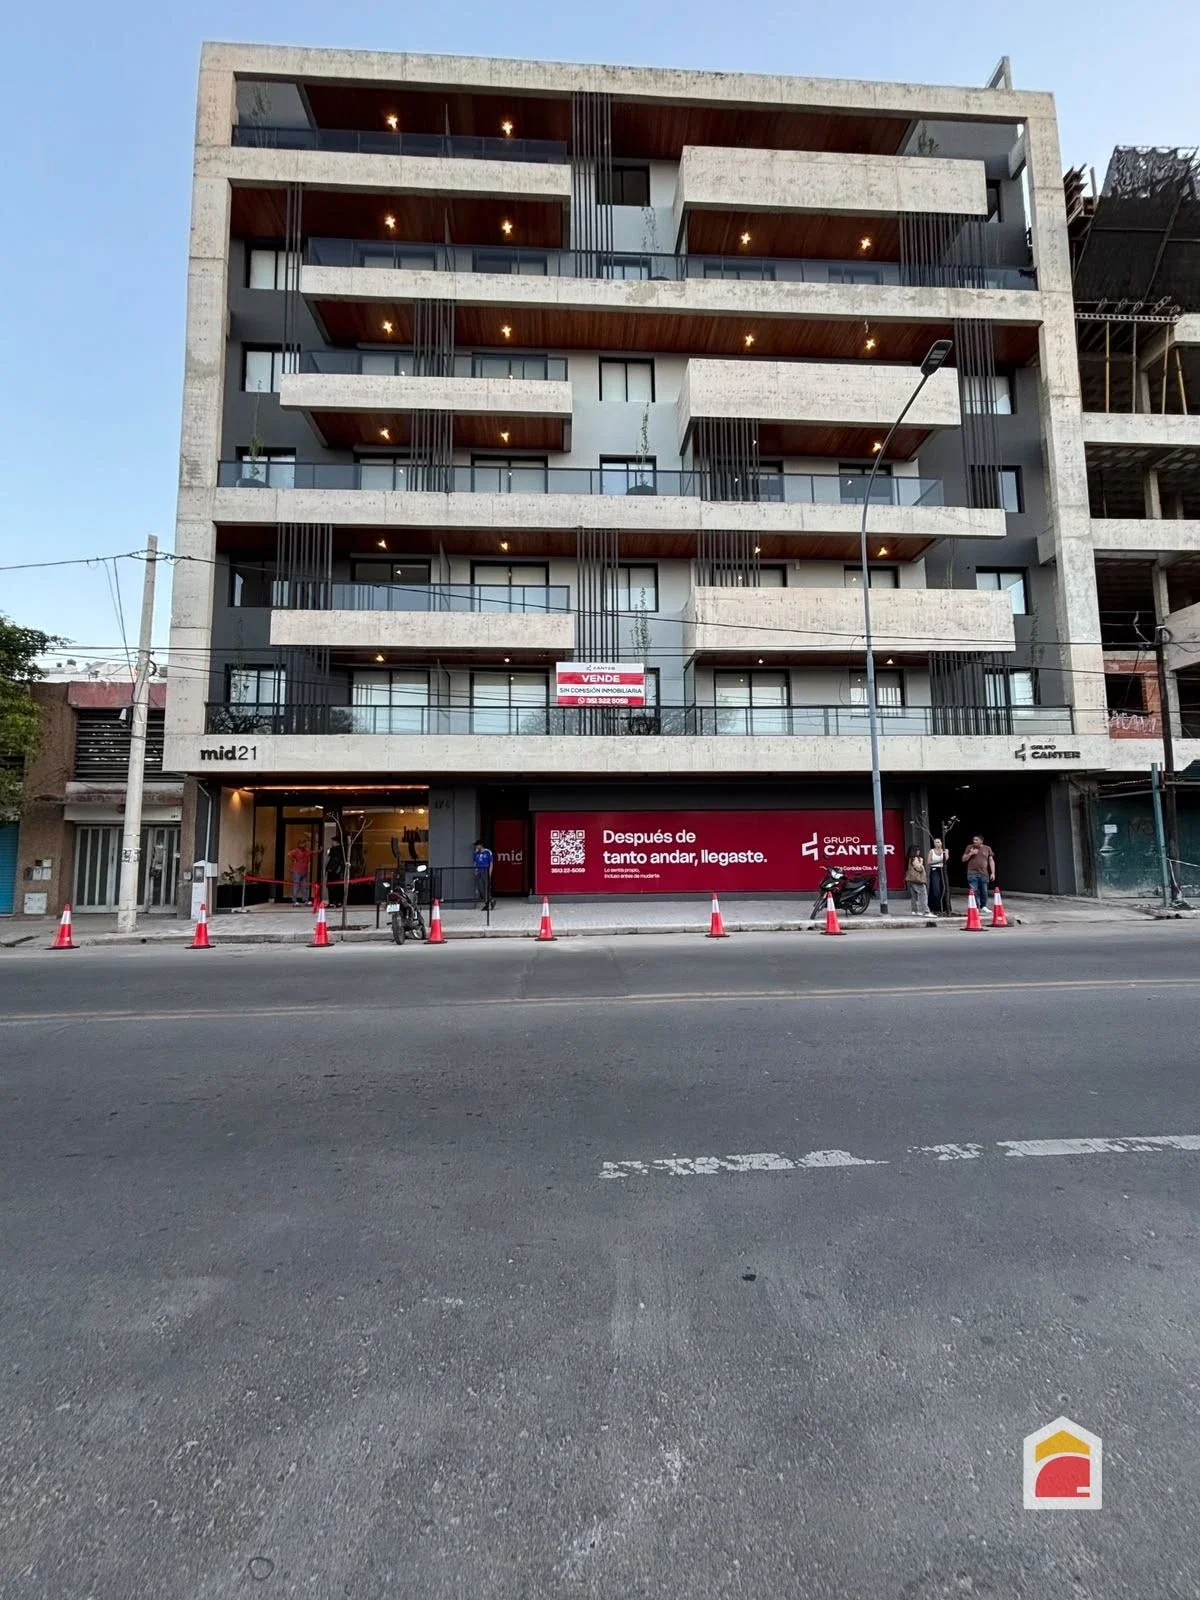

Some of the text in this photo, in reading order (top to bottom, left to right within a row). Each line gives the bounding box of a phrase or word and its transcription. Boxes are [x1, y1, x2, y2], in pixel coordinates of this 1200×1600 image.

[581, 674, 620, 683] VENDE
[200, 745, 256, 760] mid21
[1031, 751, 1080, 759] CANTER
[603, 829, 696, 846] Después de
[823, 836, 860, 844] GRUPO
[497, 850, 523, 861] mid
[603, 849, 768, 866] tanto andar, llegaste.
